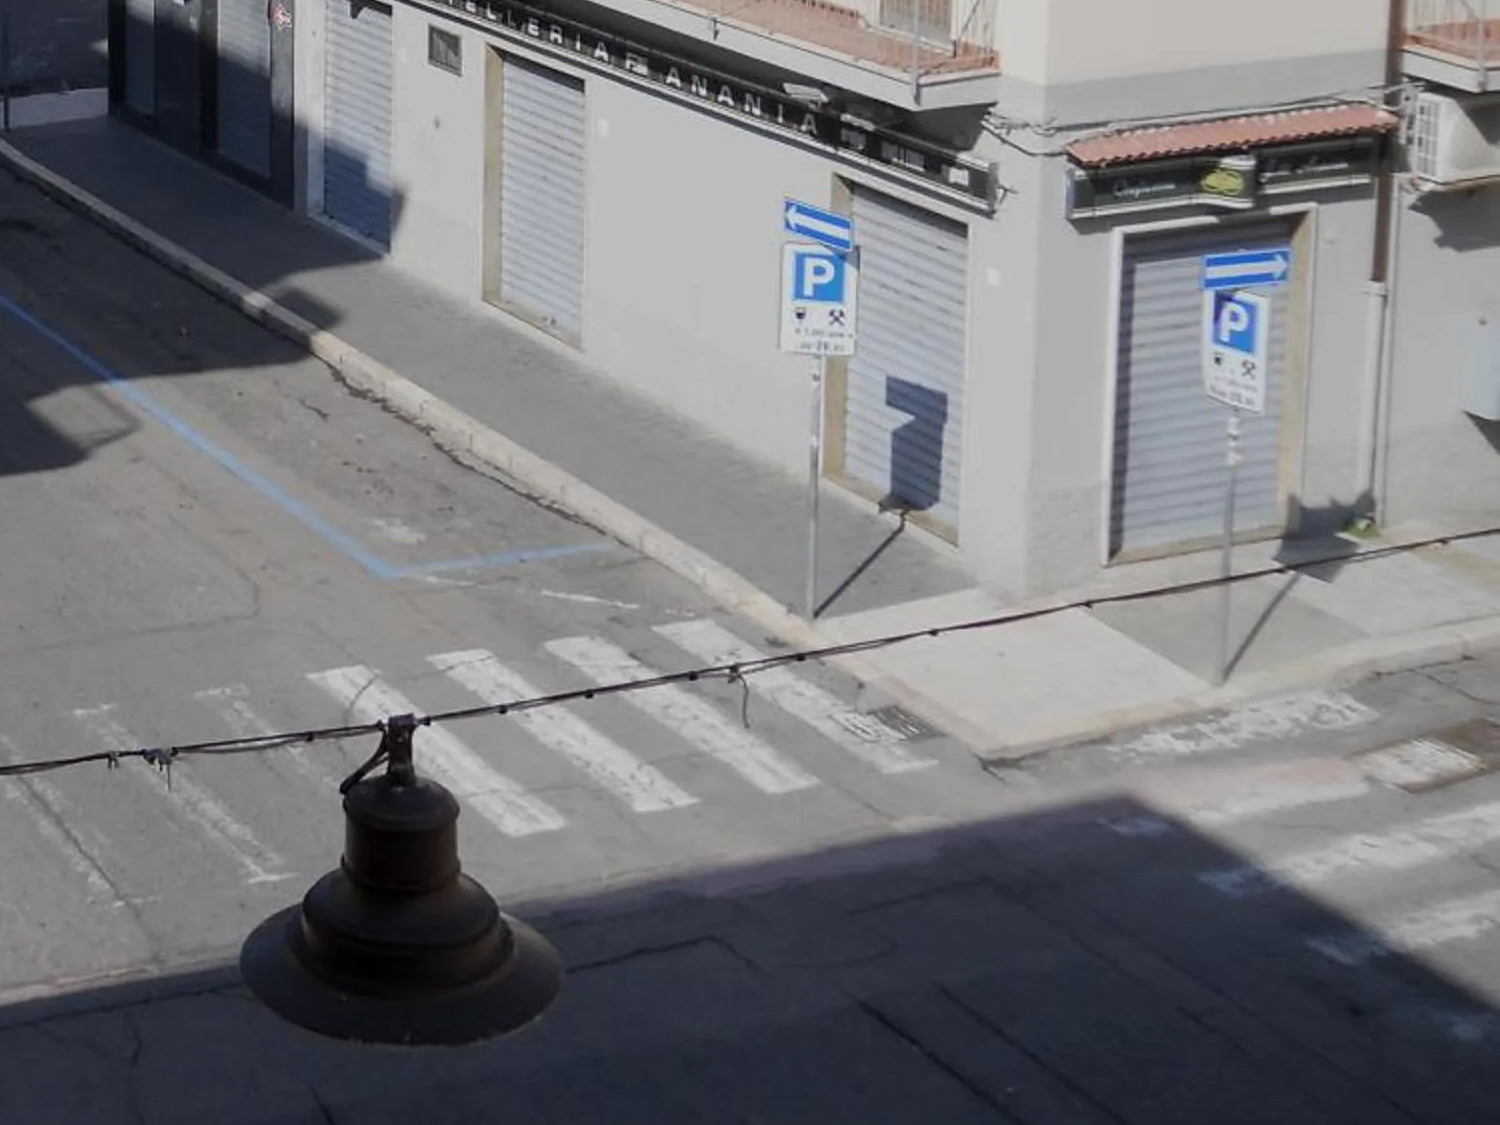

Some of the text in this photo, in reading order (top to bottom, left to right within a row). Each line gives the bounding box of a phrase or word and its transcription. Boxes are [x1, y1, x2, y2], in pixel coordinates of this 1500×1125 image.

[665, 66, 818, 137] ANANIA
[802, 257, 836, 298] P
[1221, 301, 1249, 342] P
